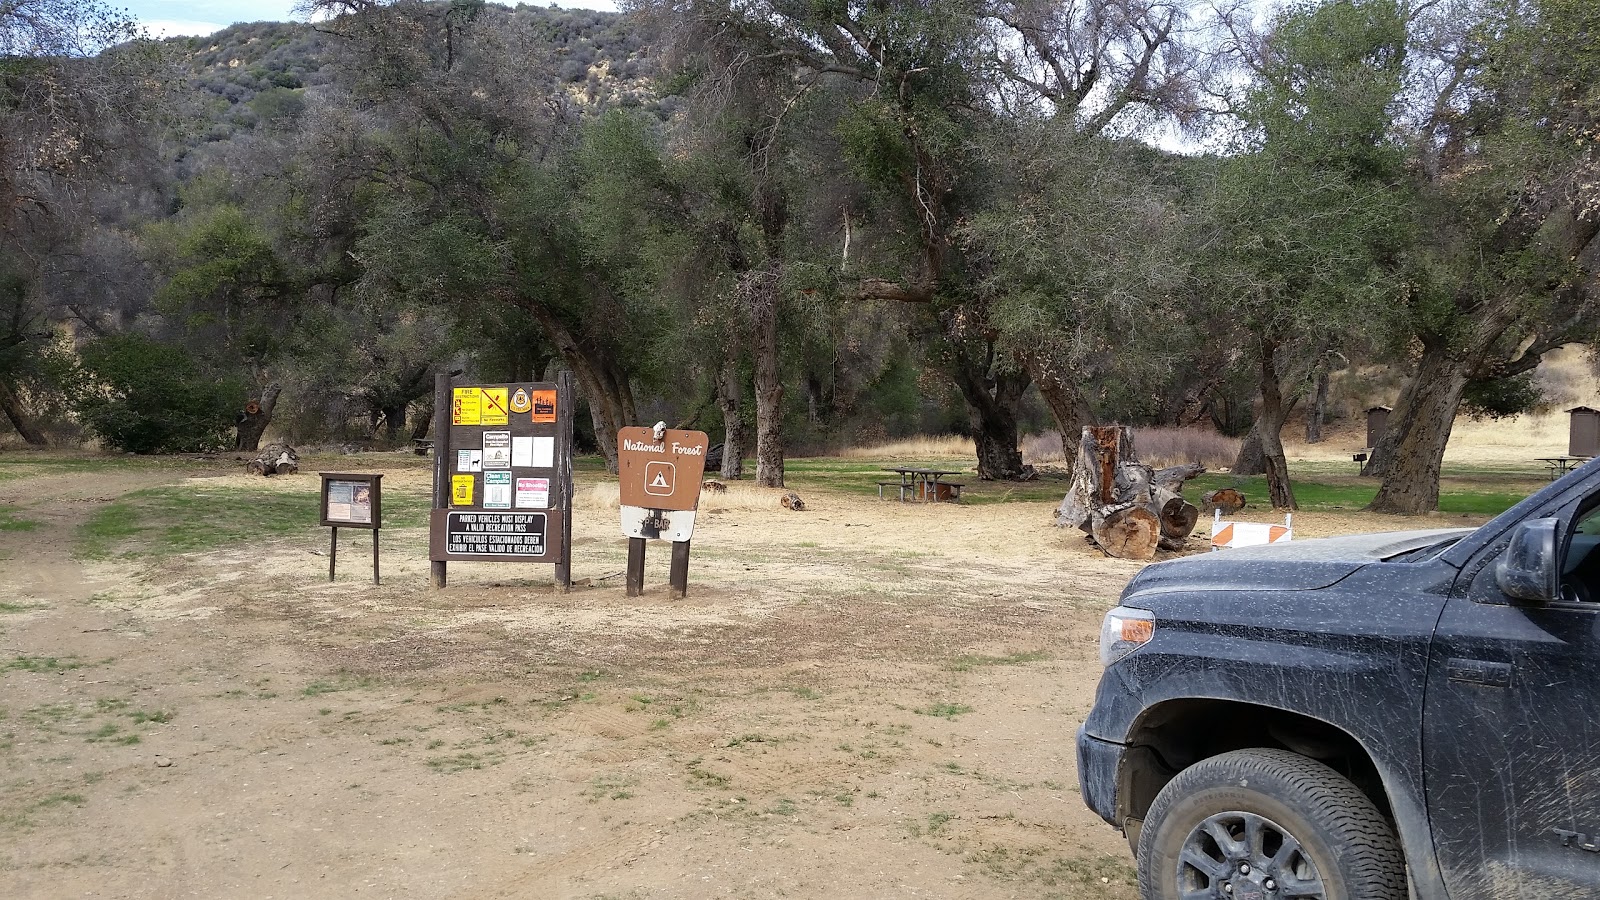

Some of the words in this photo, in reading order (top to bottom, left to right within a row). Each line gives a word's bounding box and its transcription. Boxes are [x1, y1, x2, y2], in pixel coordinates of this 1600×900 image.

[623, 438, 665, 454] National
[671, 441, 703, 456] Forest
[459, 515, 477, 523] PARKED
[478, 515, 500, 523] VEHICLES
[501, 515, 513, 523] MUST
[514, 515, 534, 524] DISPLAY
[471, 524, 484, 532] VALID
[485, 524, 514, 532] RECREATION
[515, 524, 527, 532] PASS
[452, 535, 462, 543] LOS
[462, 535, 488, 544] VEHICULOS
[489, 535, 523, 544] ESTACIONADOS
[524, 536, 540, 544] DEBEN
[449, 543, 468, 552] EXHIBIR
[468, 543, 475, 552] EL
[475, 544, 488, 552] PASE
[489, 544, 505, 553] VALIDO
[506, 545, 513, 553] DE
[514, 545, 543, 554] RECREACION
